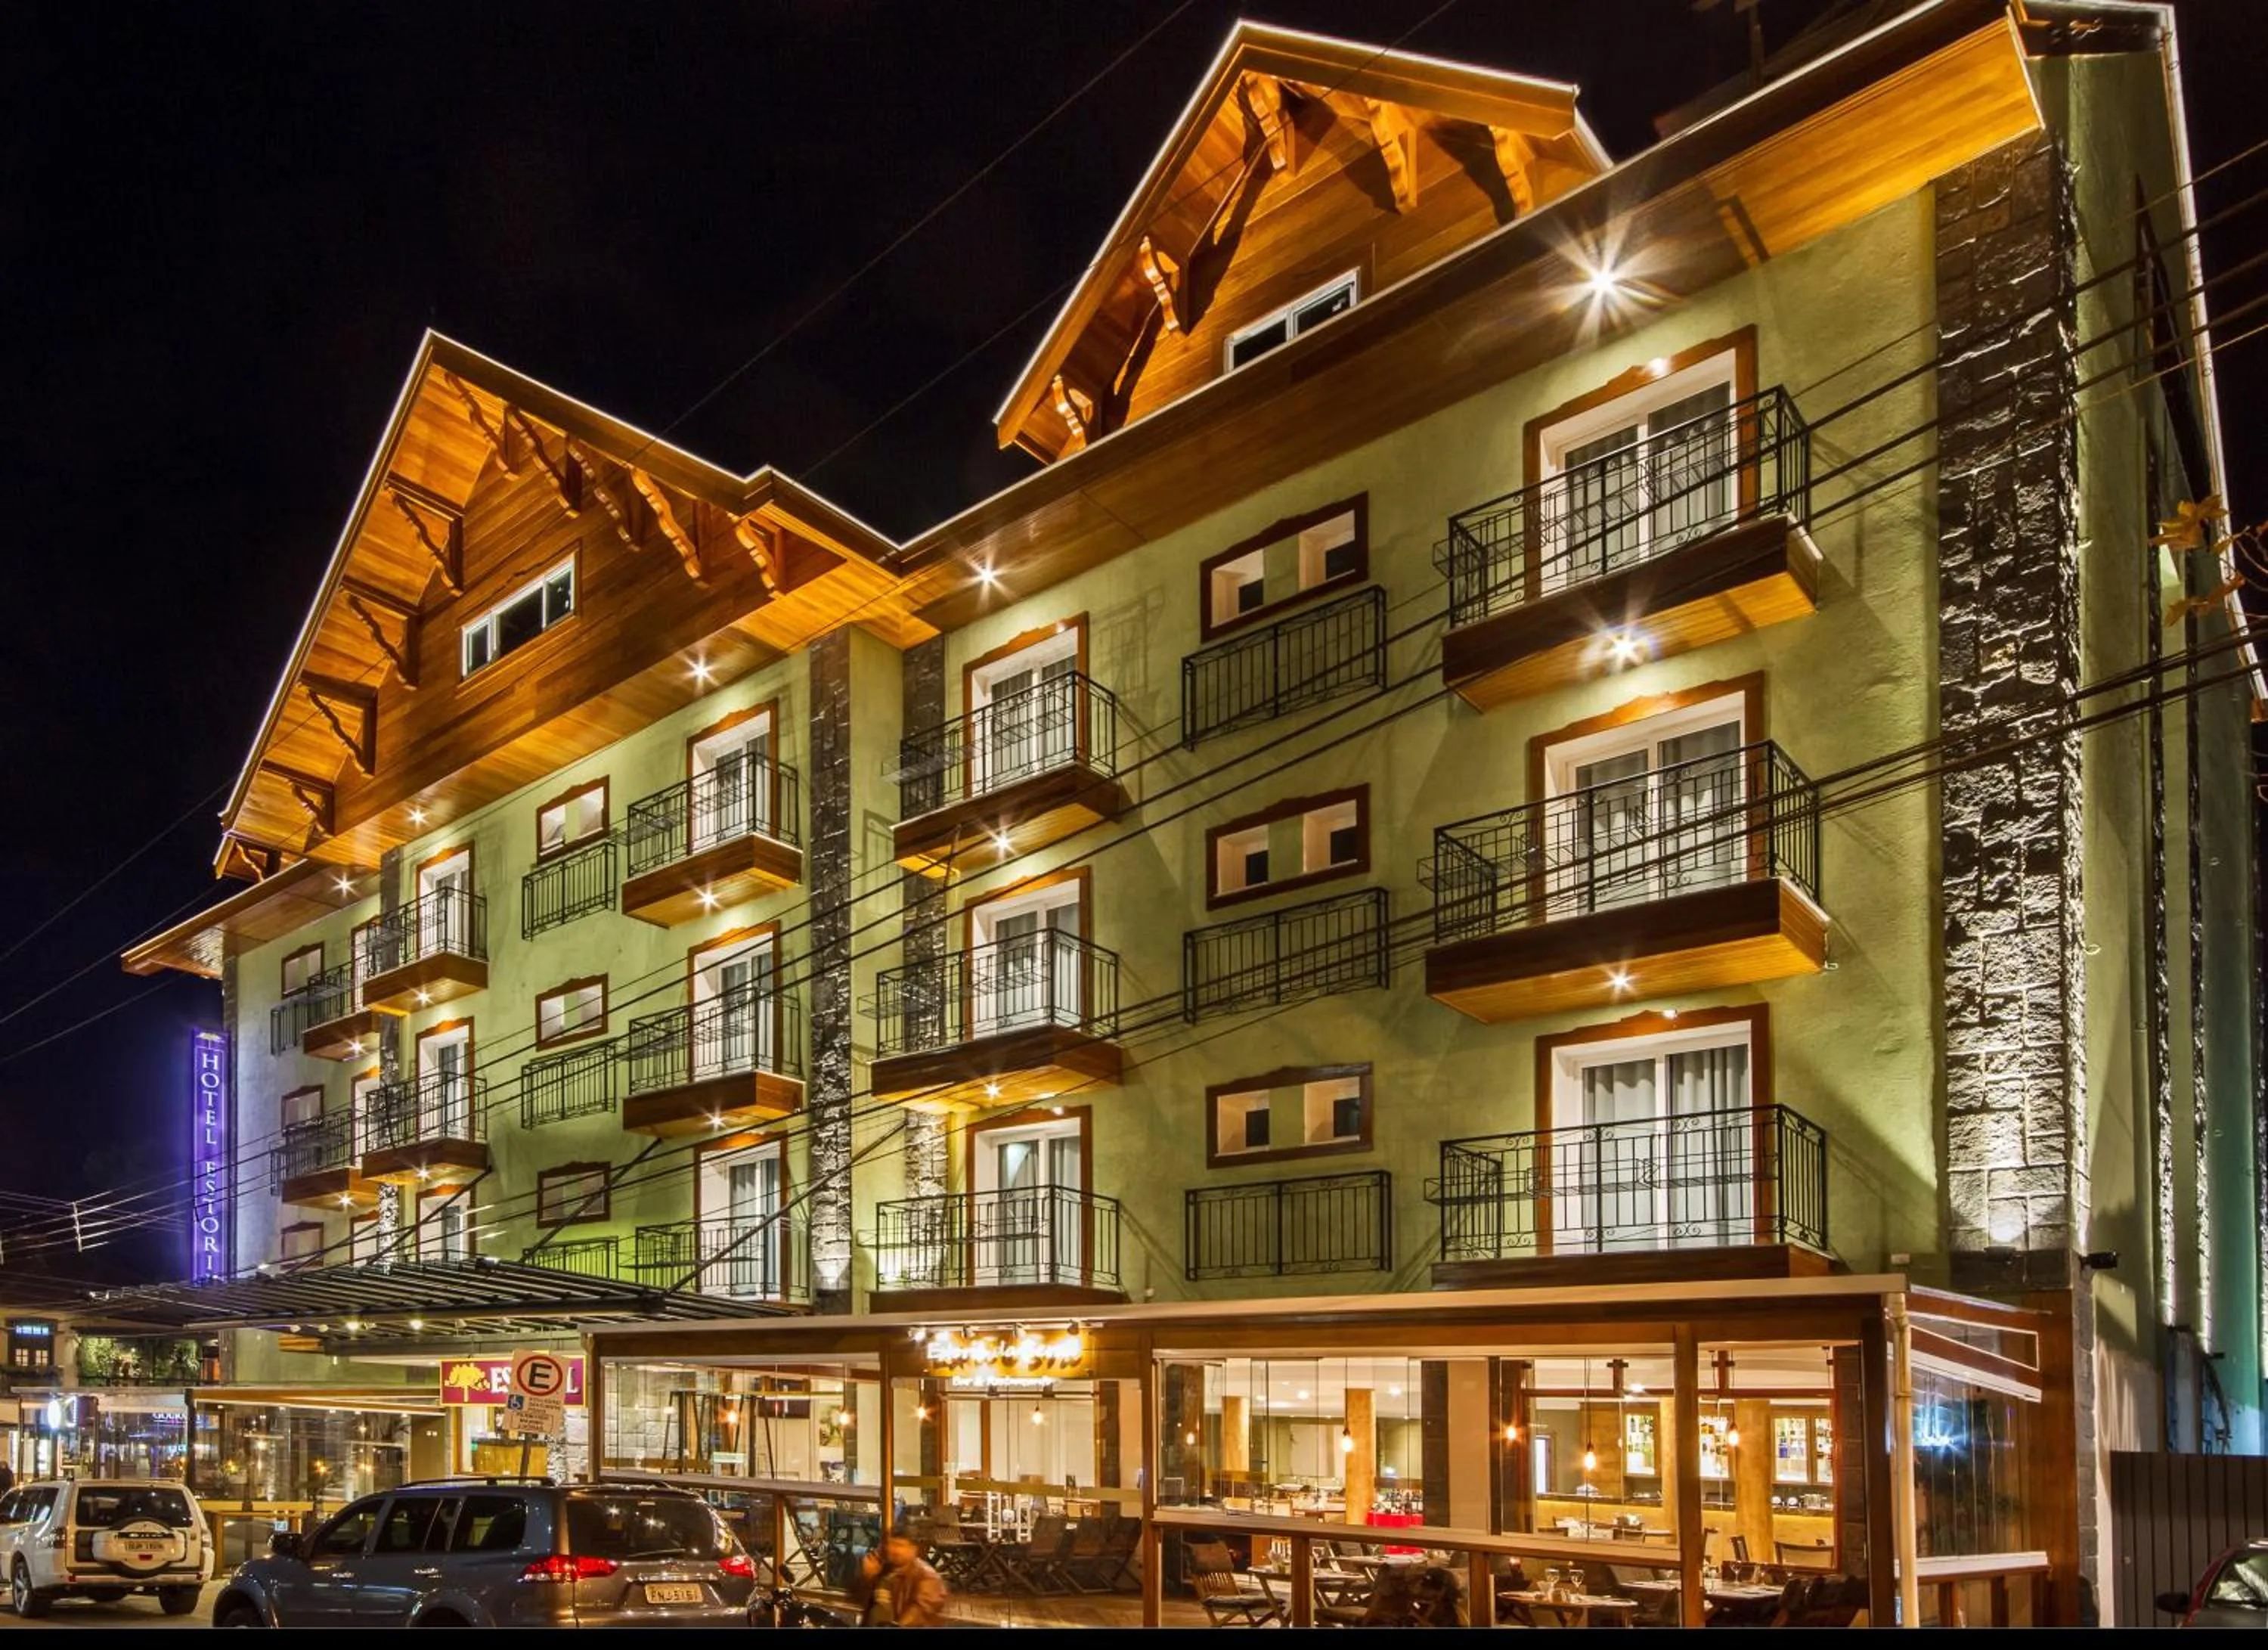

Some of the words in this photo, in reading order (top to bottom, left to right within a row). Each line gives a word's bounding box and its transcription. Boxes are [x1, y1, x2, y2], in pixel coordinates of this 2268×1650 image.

[200, 1054, 219, 1144] HOTEL
[200, 1162, 218, 1278] ESTORI
[528, 1363, 552, 1389] E
